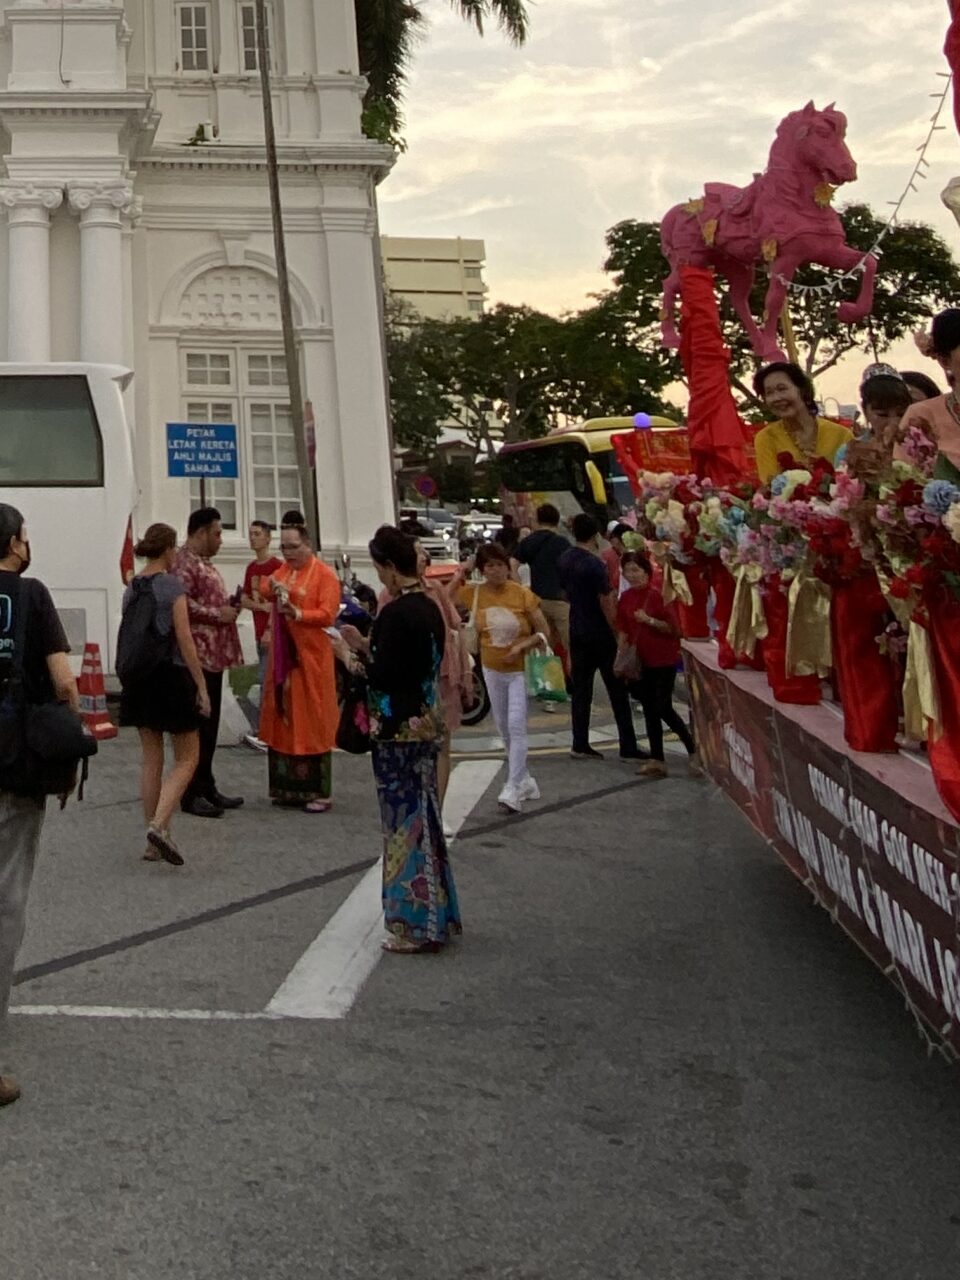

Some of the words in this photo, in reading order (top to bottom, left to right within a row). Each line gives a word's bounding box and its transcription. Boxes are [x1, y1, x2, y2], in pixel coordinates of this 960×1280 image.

[186, 428, 215, 437] PETAK
[168, 439, 196, 448] LETAK
[201, 440, 235, 449] KERETA
[174, 451, 194, 460] AHLI
[199, 452, 232, 461] MAJLIS
[184, 464, 222, 473] SAHAJA
[881, 819, 915, 885] GOH
[912, 842, 953, 916] MEH
[874, 882, 938, 1000] MARI
